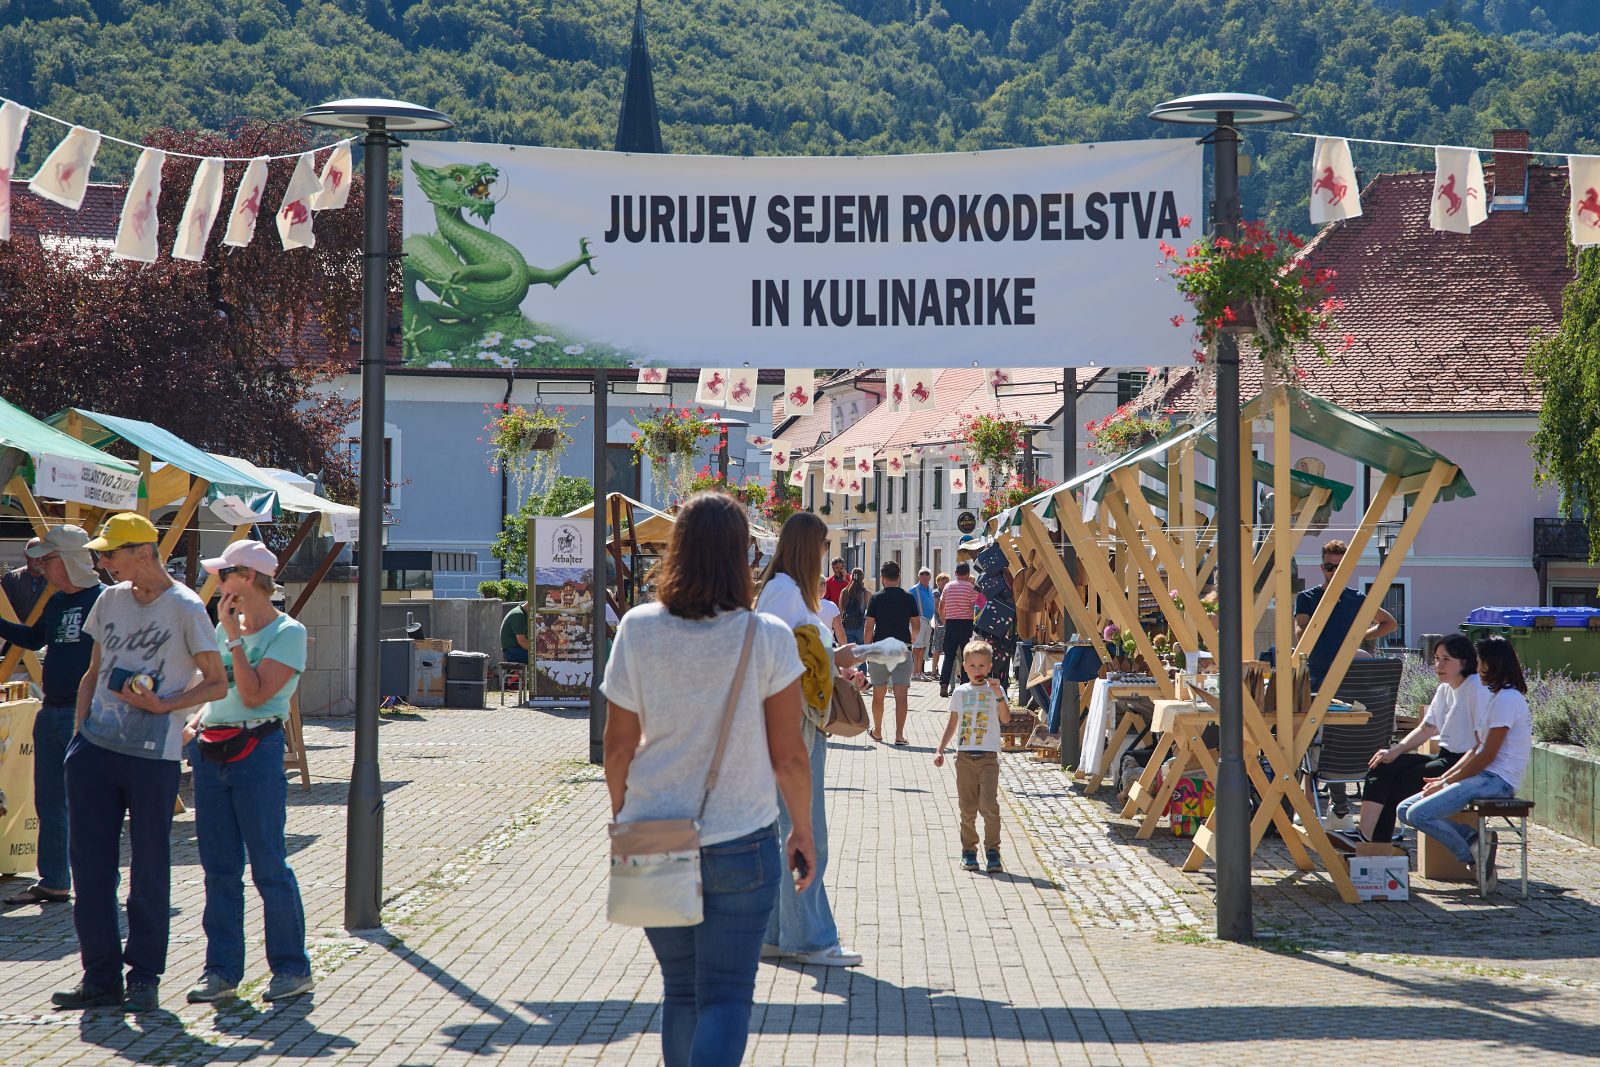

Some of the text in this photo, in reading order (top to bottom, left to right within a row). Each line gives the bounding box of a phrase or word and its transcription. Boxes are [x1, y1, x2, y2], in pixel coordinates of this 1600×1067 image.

[605, 190, 1182, 244] JURIJEV SEJEM ROKODELSTVA
[752, 277, 1036, 327] IN KULINARIKE
